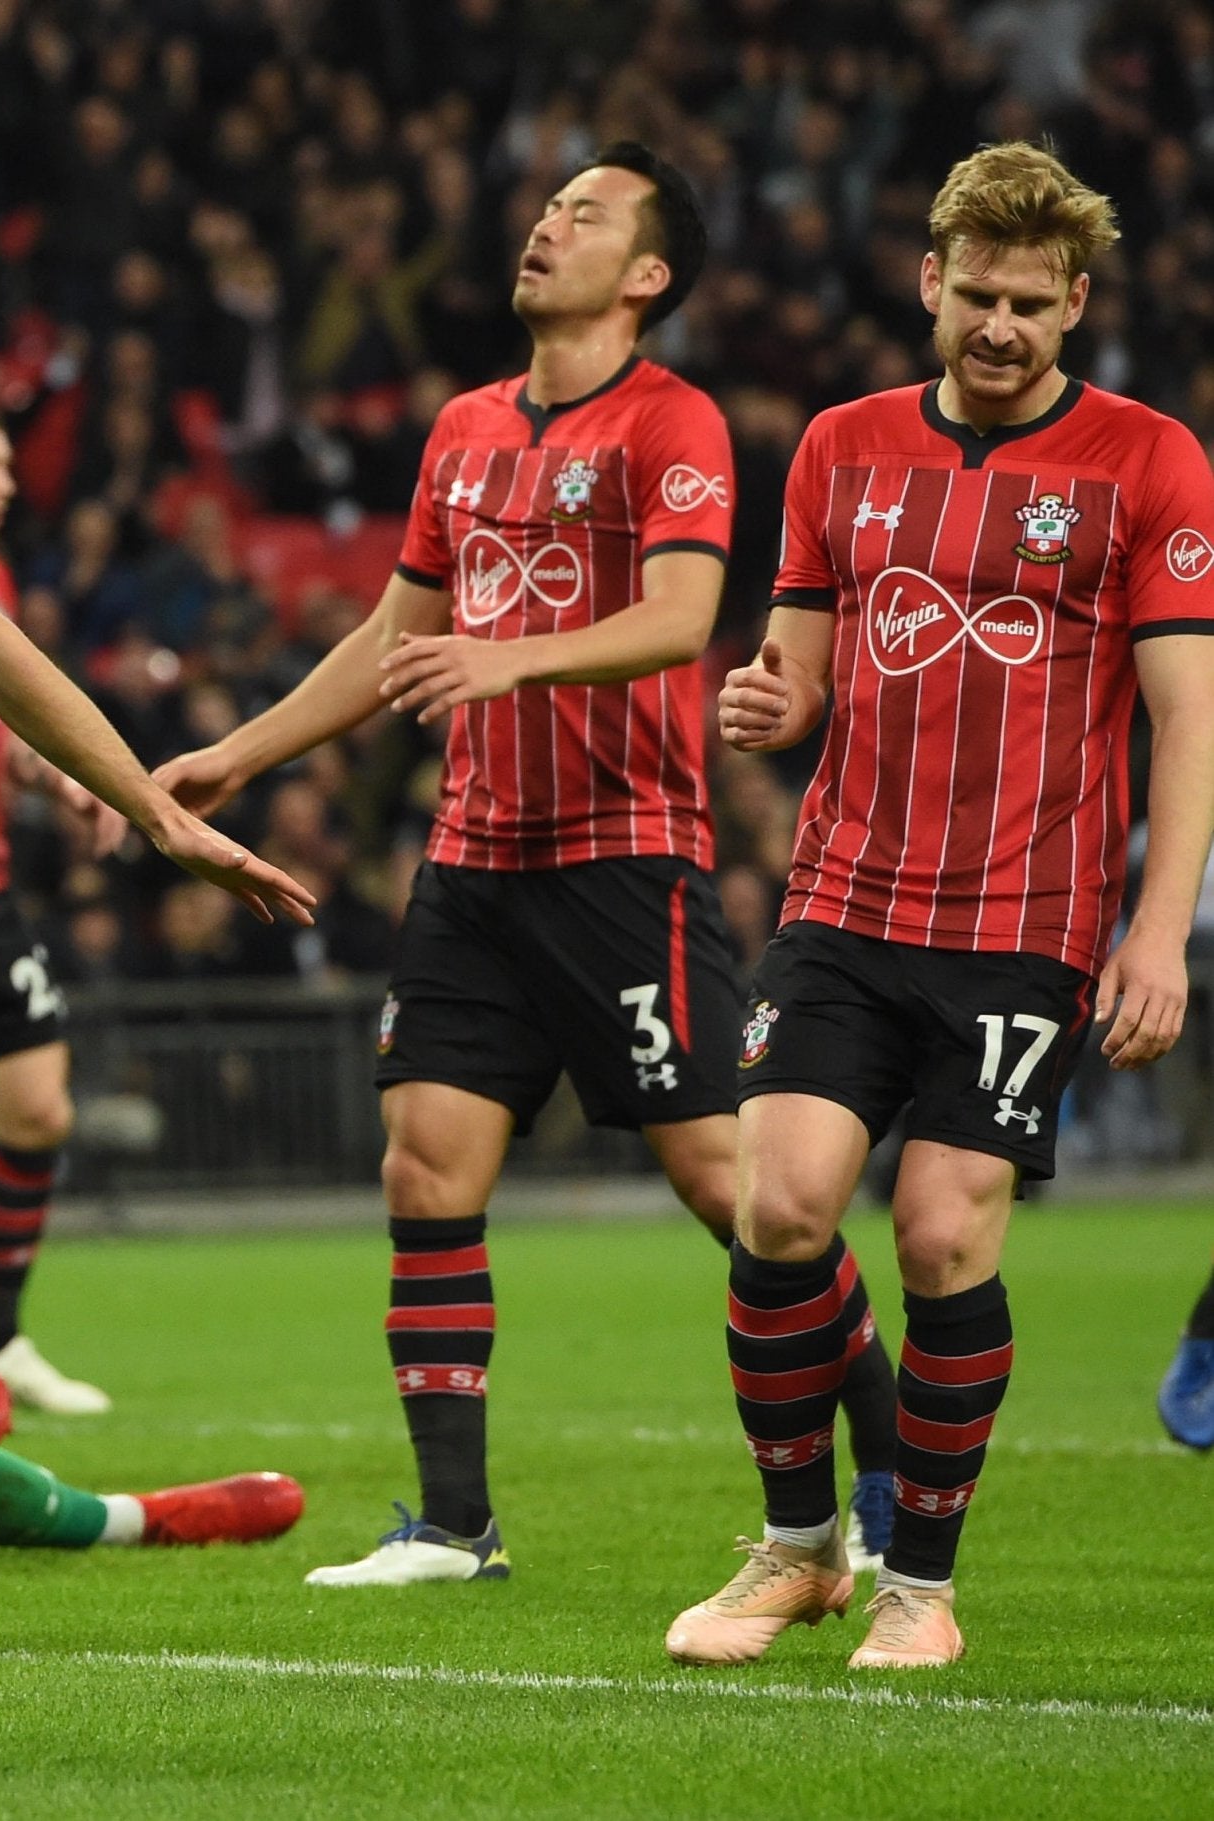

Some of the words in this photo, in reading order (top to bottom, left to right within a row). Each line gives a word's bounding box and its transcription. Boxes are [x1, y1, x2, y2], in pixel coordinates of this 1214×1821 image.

[468, 547, 514, 607] Virgin
[532, 565, 575, 581] media
[1173, 537, 1207, 571] Virgin
[875, 586, 947, 656] Virgin
[980, 620, 1035, 637] media
[620, 983, 670, 1064] 3
[976, 1013, 1060, 1097] 17
